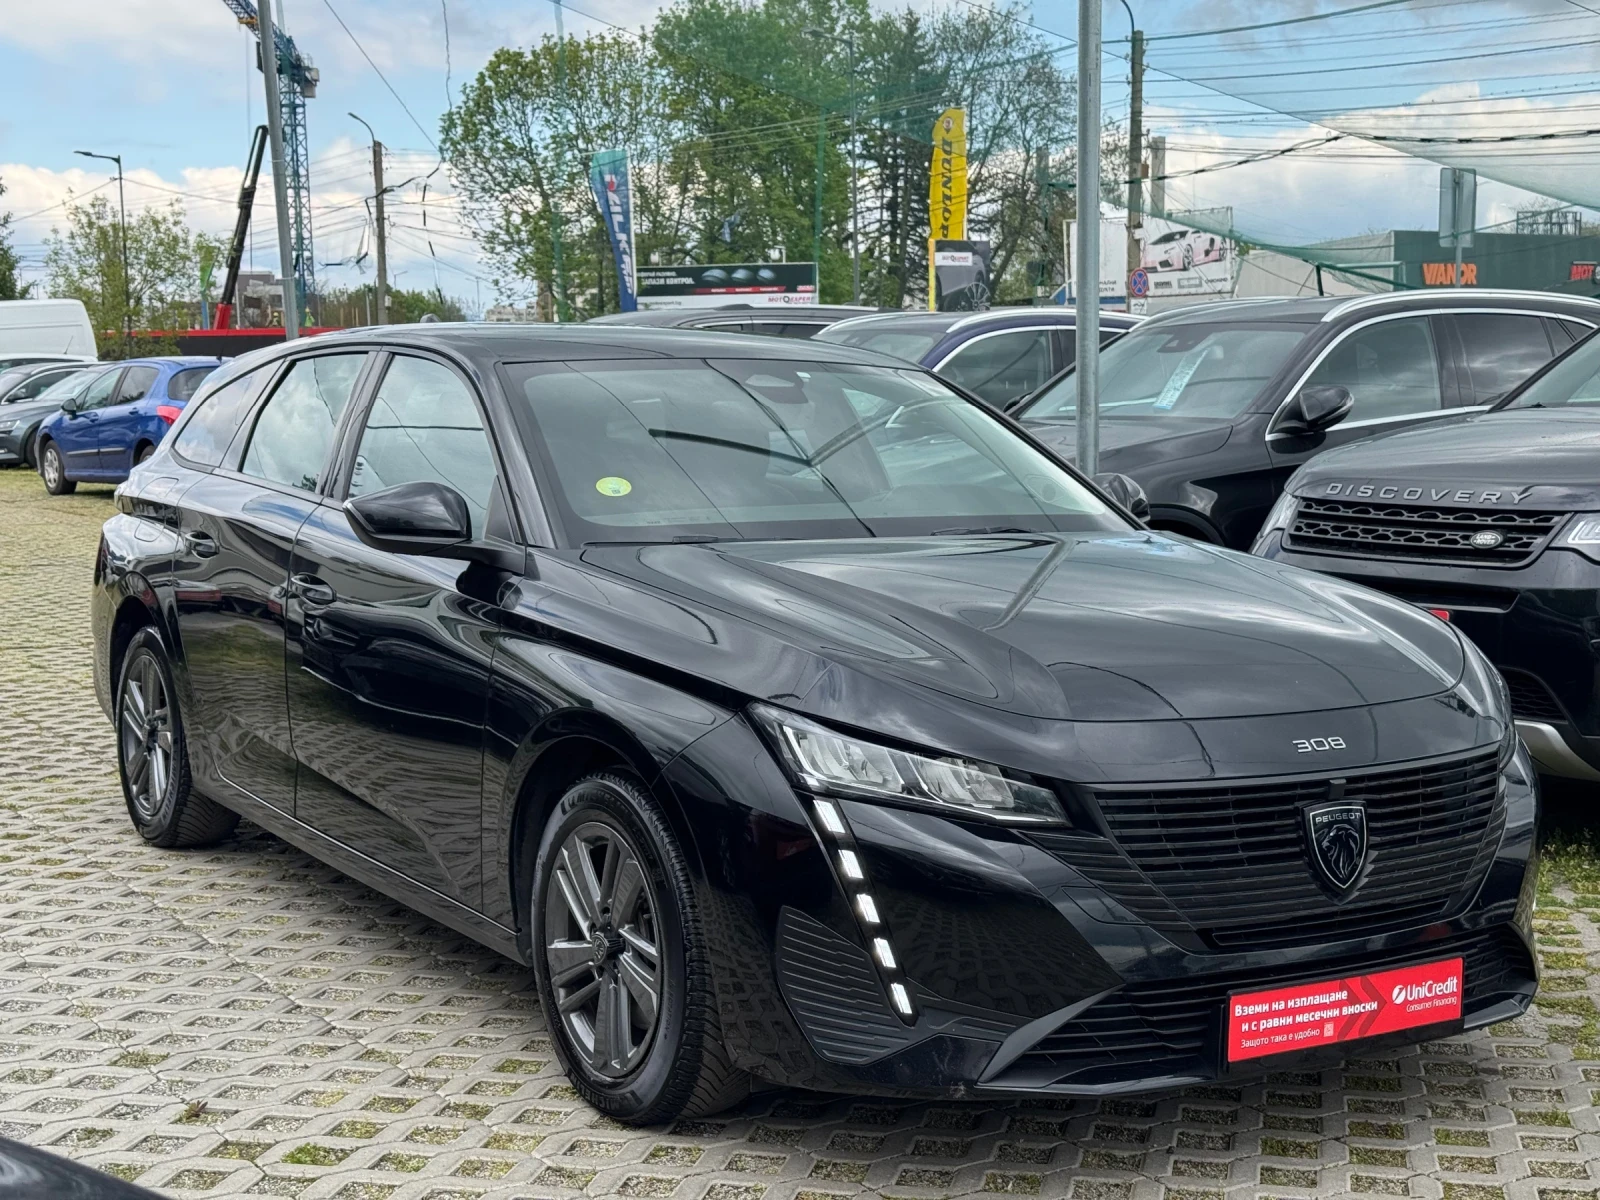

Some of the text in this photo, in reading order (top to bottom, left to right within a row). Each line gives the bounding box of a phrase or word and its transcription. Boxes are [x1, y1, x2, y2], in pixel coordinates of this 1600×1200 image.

[941, 136, 952, 239] DUNLOP
[1422, 263, 1477, 285] VIANOR
[1325, 483, 1532, 505] DISCOVERY
[1292, 736, 1346, 753] 308
[1315, 812, 1361, 824] PEUGEOT
[1406, 976, 1458, 1001] UniCredit
[1234, 989, 1349, 1017] Вземи на изплащане
[1406, 996, 1457, 1013] Consumer Financing
[1241, 1000, 1378, 1032] и с равни месечни вноски
[1240, 1028, 1321, 1049] Защото така е удобно
